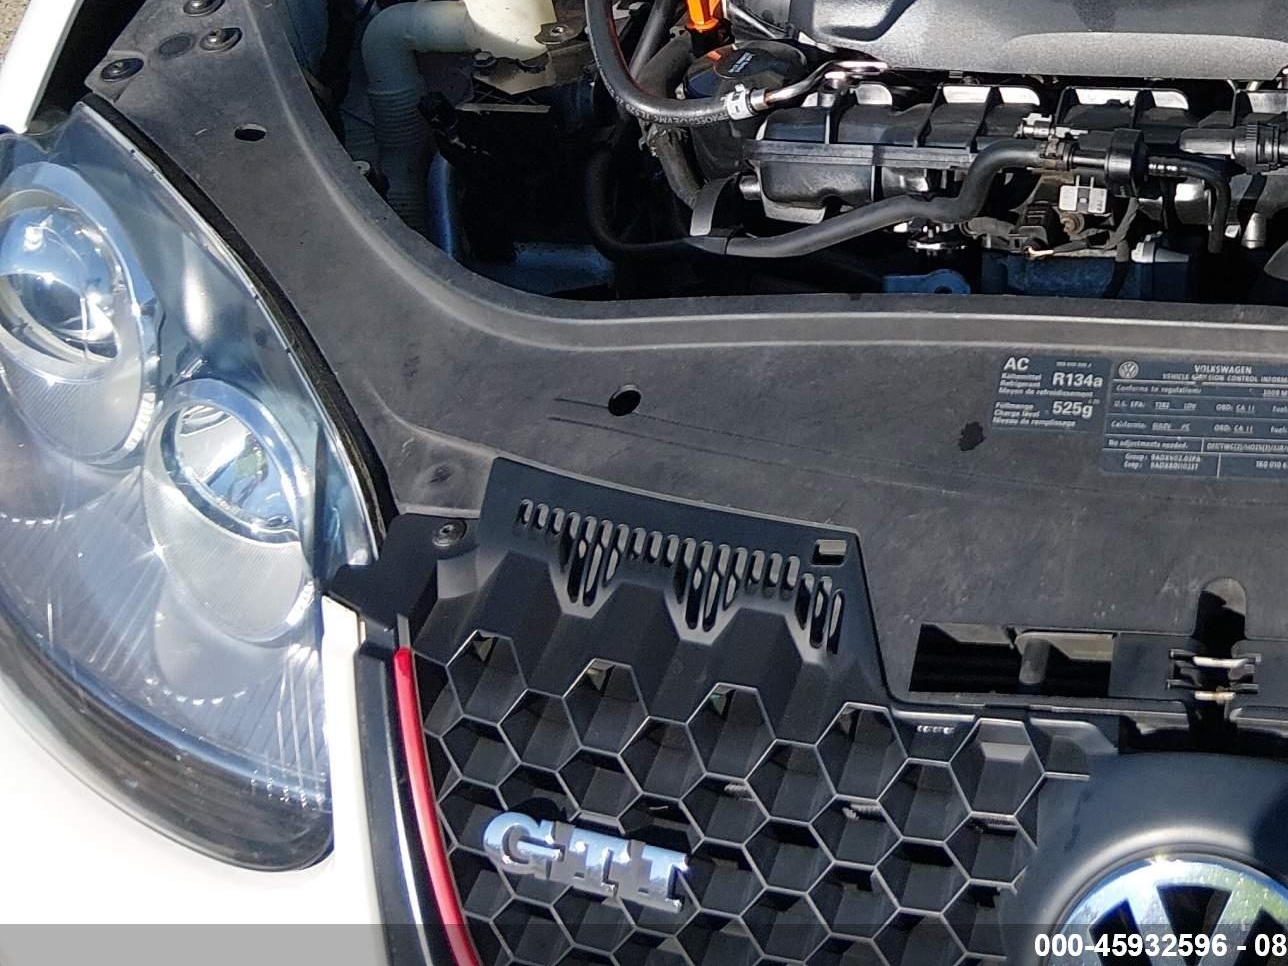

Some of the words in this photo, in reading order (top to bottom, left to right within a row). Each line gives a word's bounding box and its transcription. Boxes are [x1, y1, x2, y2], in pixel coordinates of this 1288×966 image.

[1003, 357, 1030, 371] AC
[1194, 364, 1253, 375] VOLKSWAGEN
[1052, 372, 1104, 387] R134a
[1226, 375, 1258, 383] CONTROL
[1052, 401, 1093, 419] 525g
